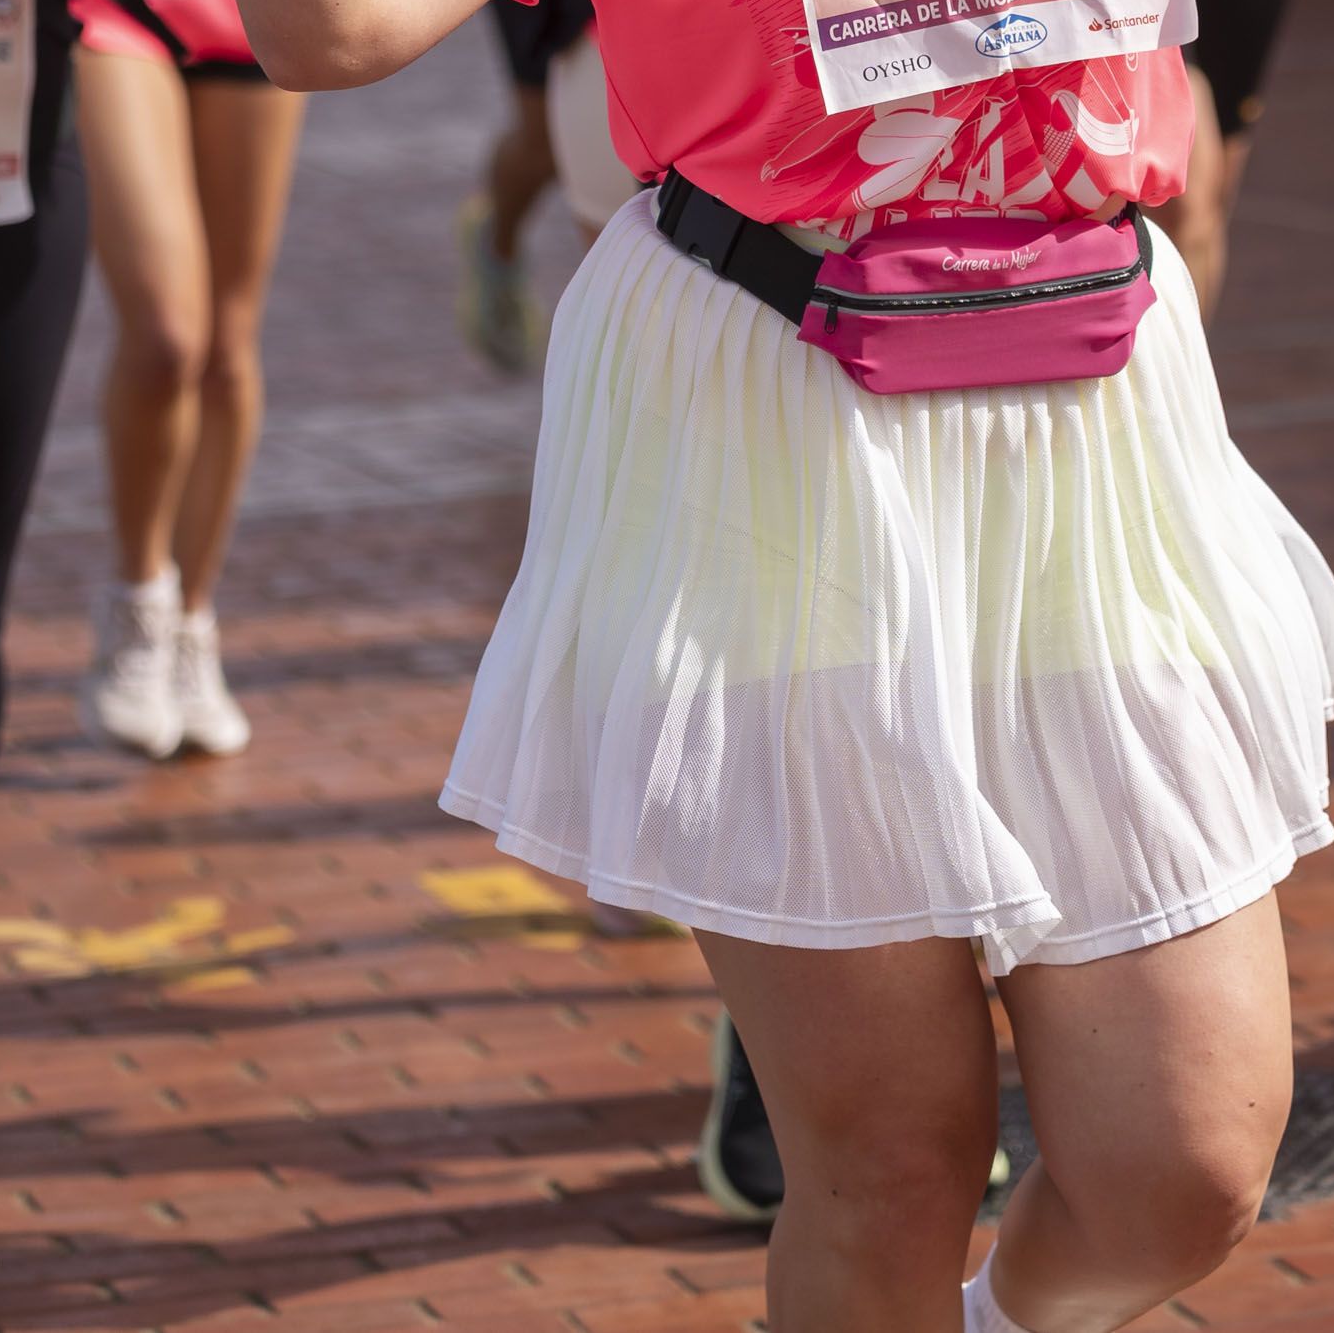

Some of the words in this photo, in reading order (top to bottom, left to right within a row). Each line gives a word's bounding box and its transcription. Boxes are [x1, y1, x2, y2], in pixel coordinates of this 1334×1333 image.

[829, 9, 912, 42] CARRERA
[917, 1, 942, 22] DE
[1104, 13, 1161, 31] Santander
[863, 54, 932, 82] OYSHO
[942, 255, 990, 272] Carrera
[991, 258, 1001, 270] de
[1009, 247, 1042, 271] Mujer
